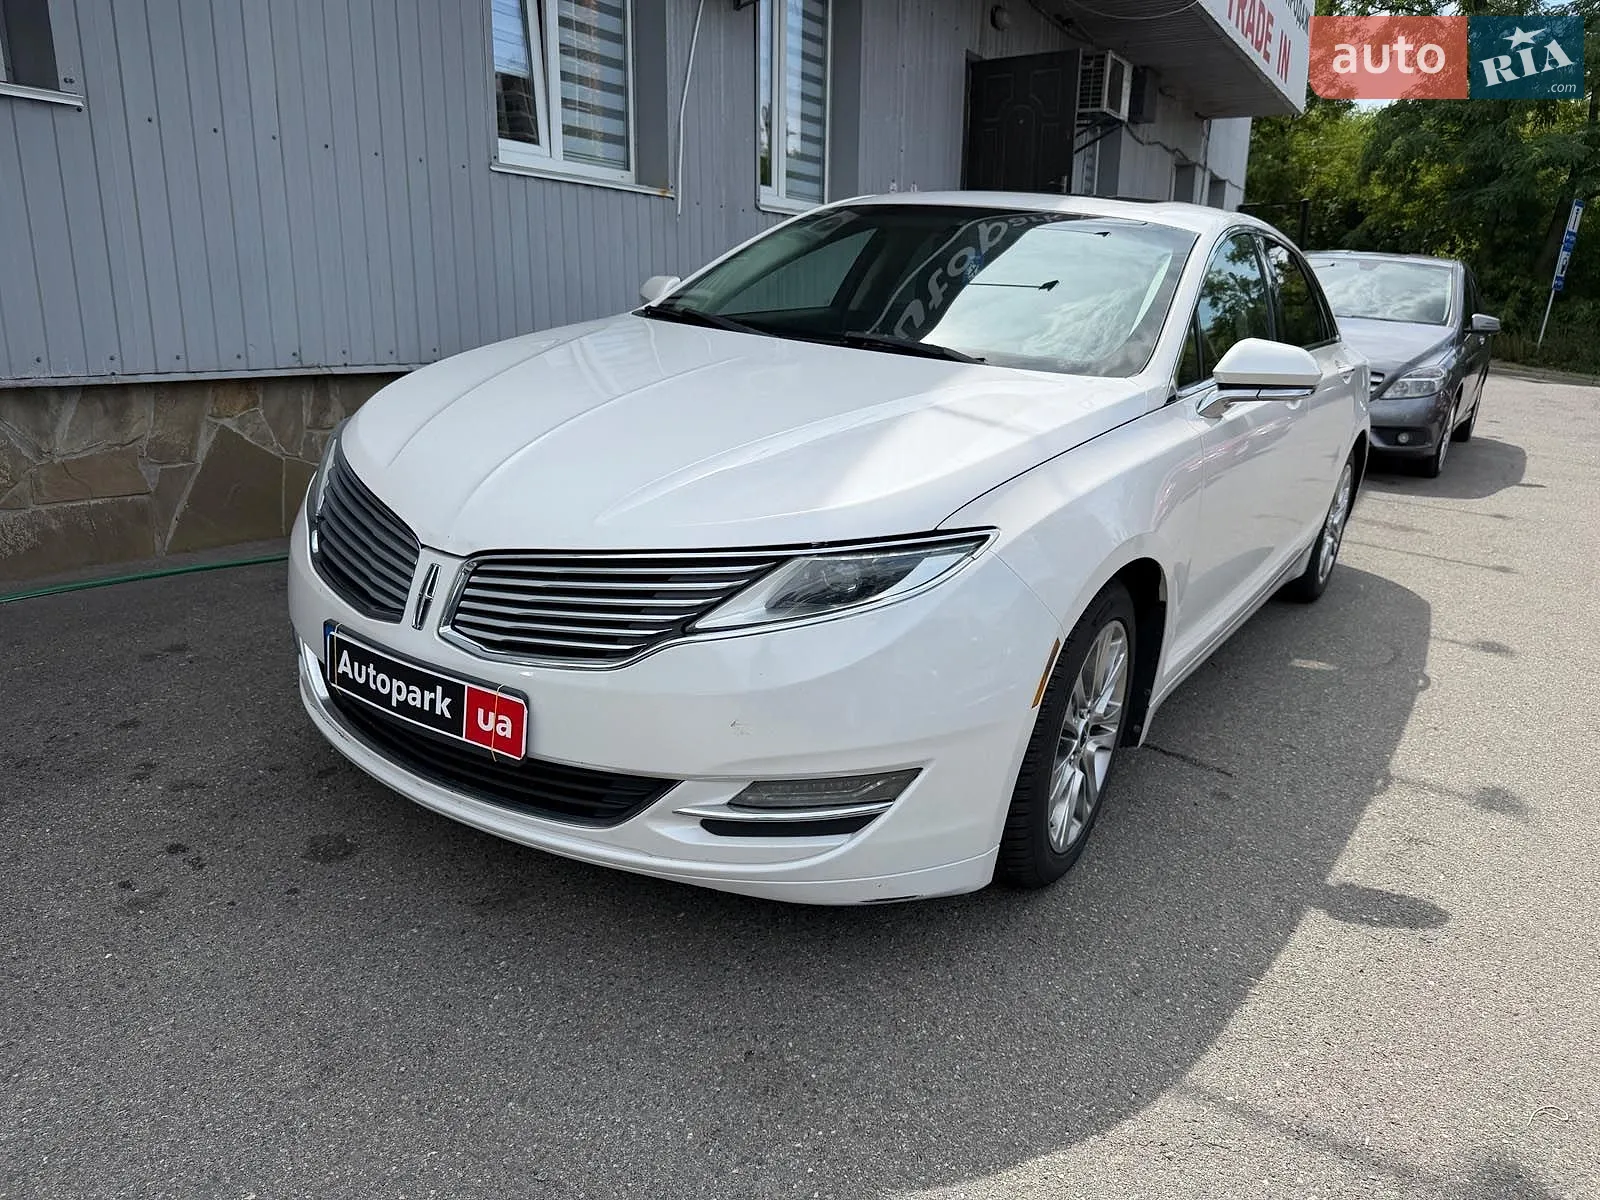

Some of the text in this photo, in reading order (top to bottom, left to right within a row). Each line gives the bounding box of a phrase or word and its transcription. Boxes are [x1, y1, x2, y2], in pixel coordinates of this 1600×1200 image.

[1277, 29, 1291, 84] IN
[337, 649, 512, 739] Autopark ua
